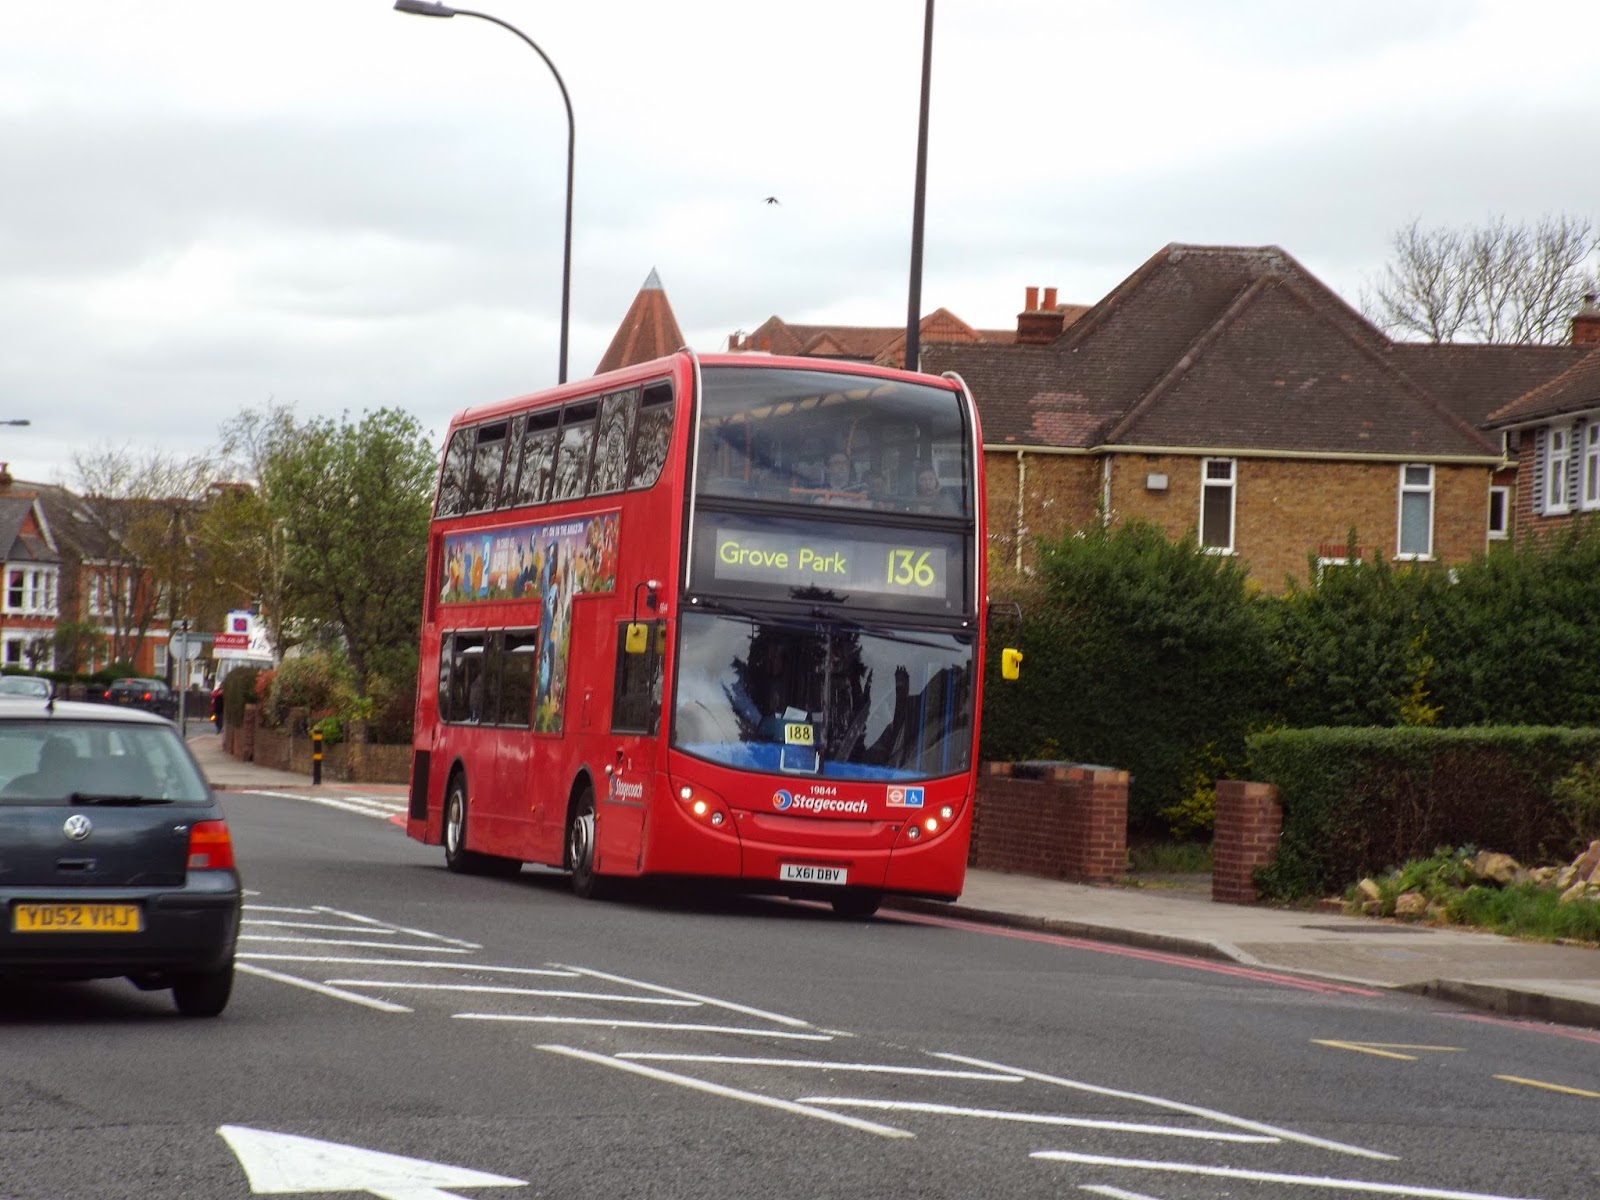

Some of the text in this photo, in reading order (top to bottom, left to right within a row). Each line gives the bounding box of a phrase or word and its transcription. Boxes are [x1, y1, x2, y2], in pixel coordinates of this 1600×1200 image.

[719, 541, 935, 587] Grove Park 136
[789, 725, 810, 740] 188
[810, 785, 837, 796] 19844
[792, 794, 868, 813] Stagecoach
[787, 866, 840, 881] LX61 DBV
[27, 906, 129, 926] YD52 VHJ
